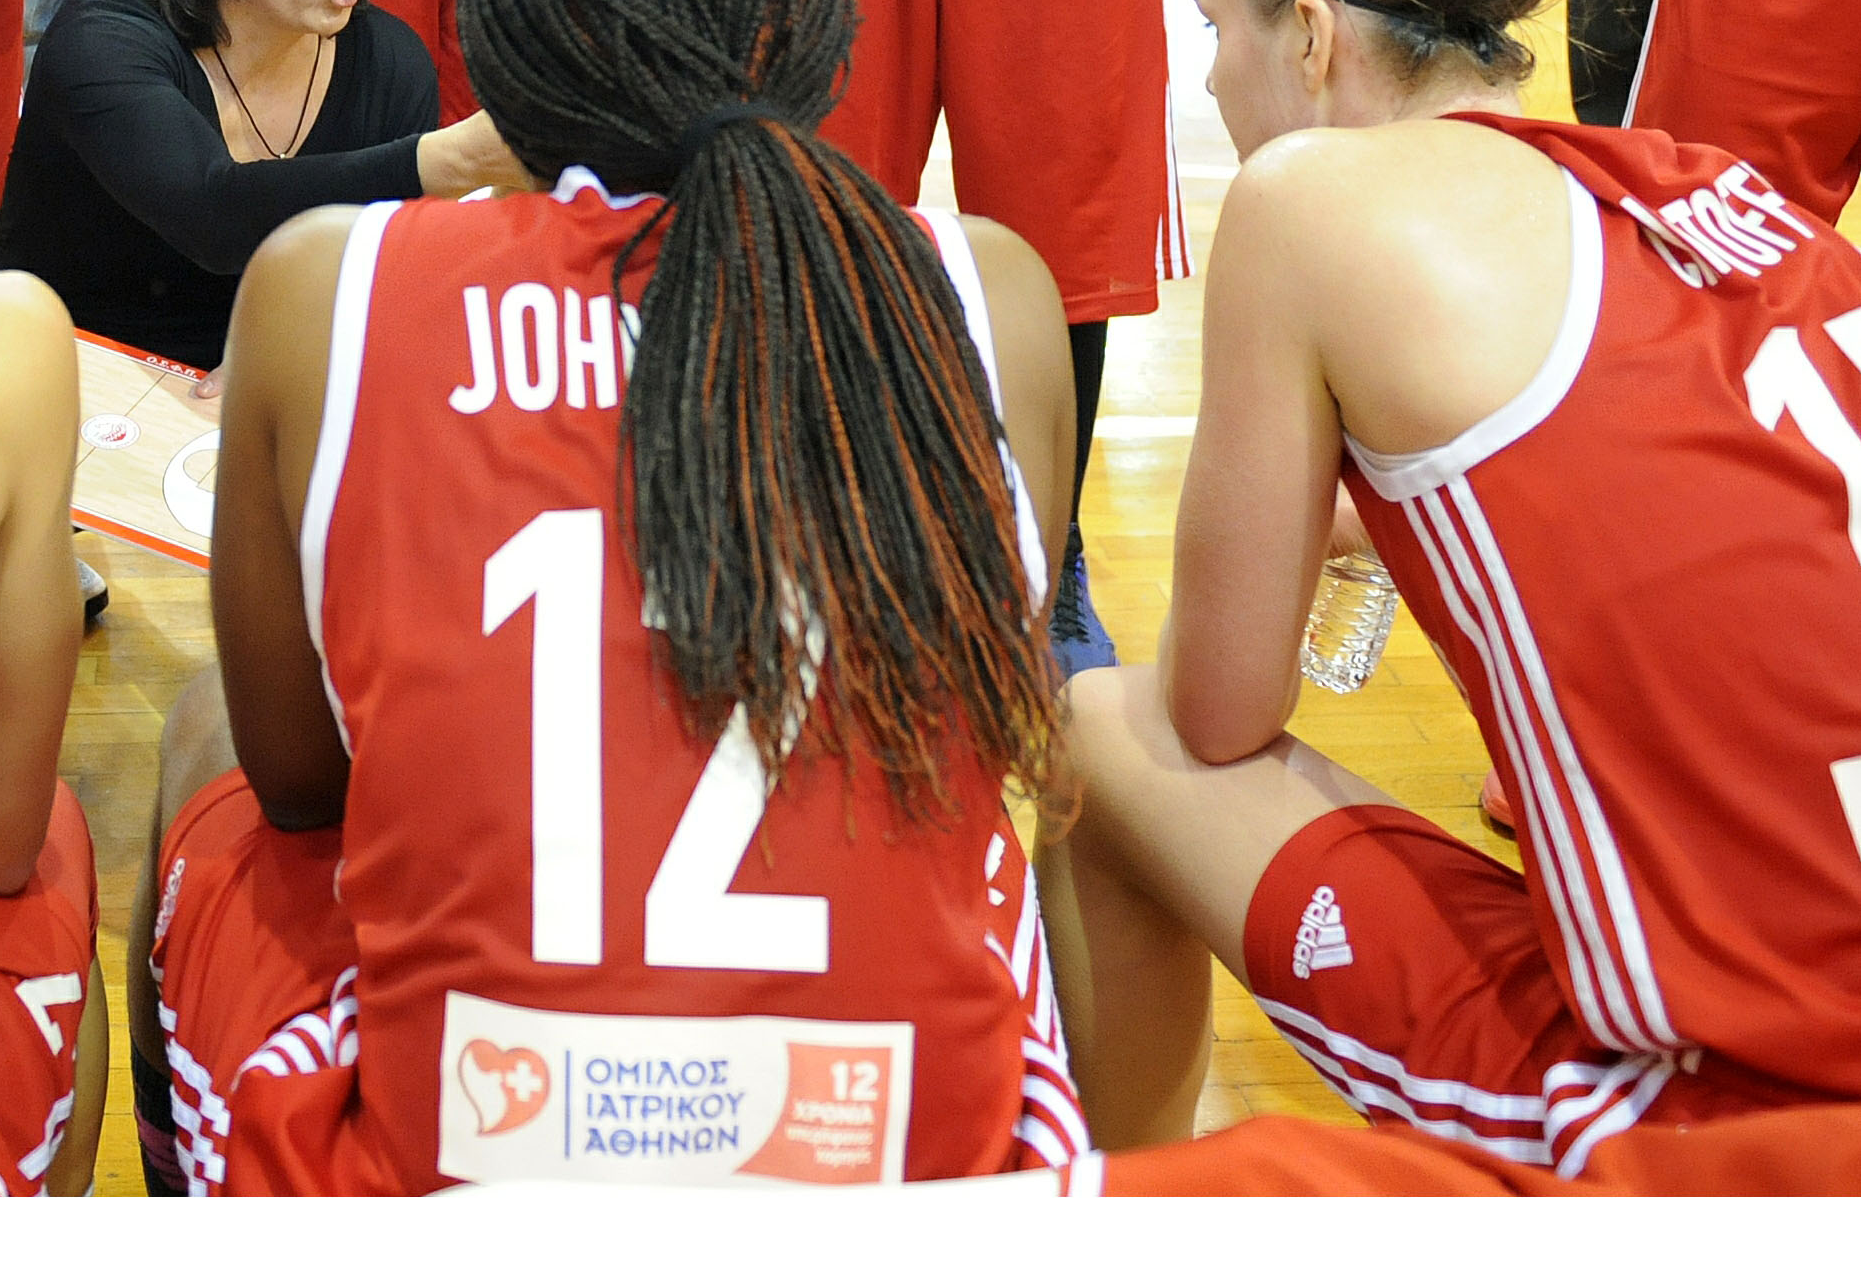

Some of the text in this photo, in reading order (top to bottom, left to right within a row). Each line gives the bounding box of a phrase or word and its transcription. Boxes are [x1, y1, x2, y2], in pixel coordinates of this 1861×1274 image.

[482, 508, 829, 973] 12
[1292, 885, 1335, 980] adidas
[584, 1058, 729, 1087] ΟΜΙΛΟΣ
[830, 1061, 879, 1101] 12
[586, 1091, 746, 1120] ΙΑΤΡΙΚΟΥ
[584, 1125, 740, 1156] ΑΘΗΝΩΝ
